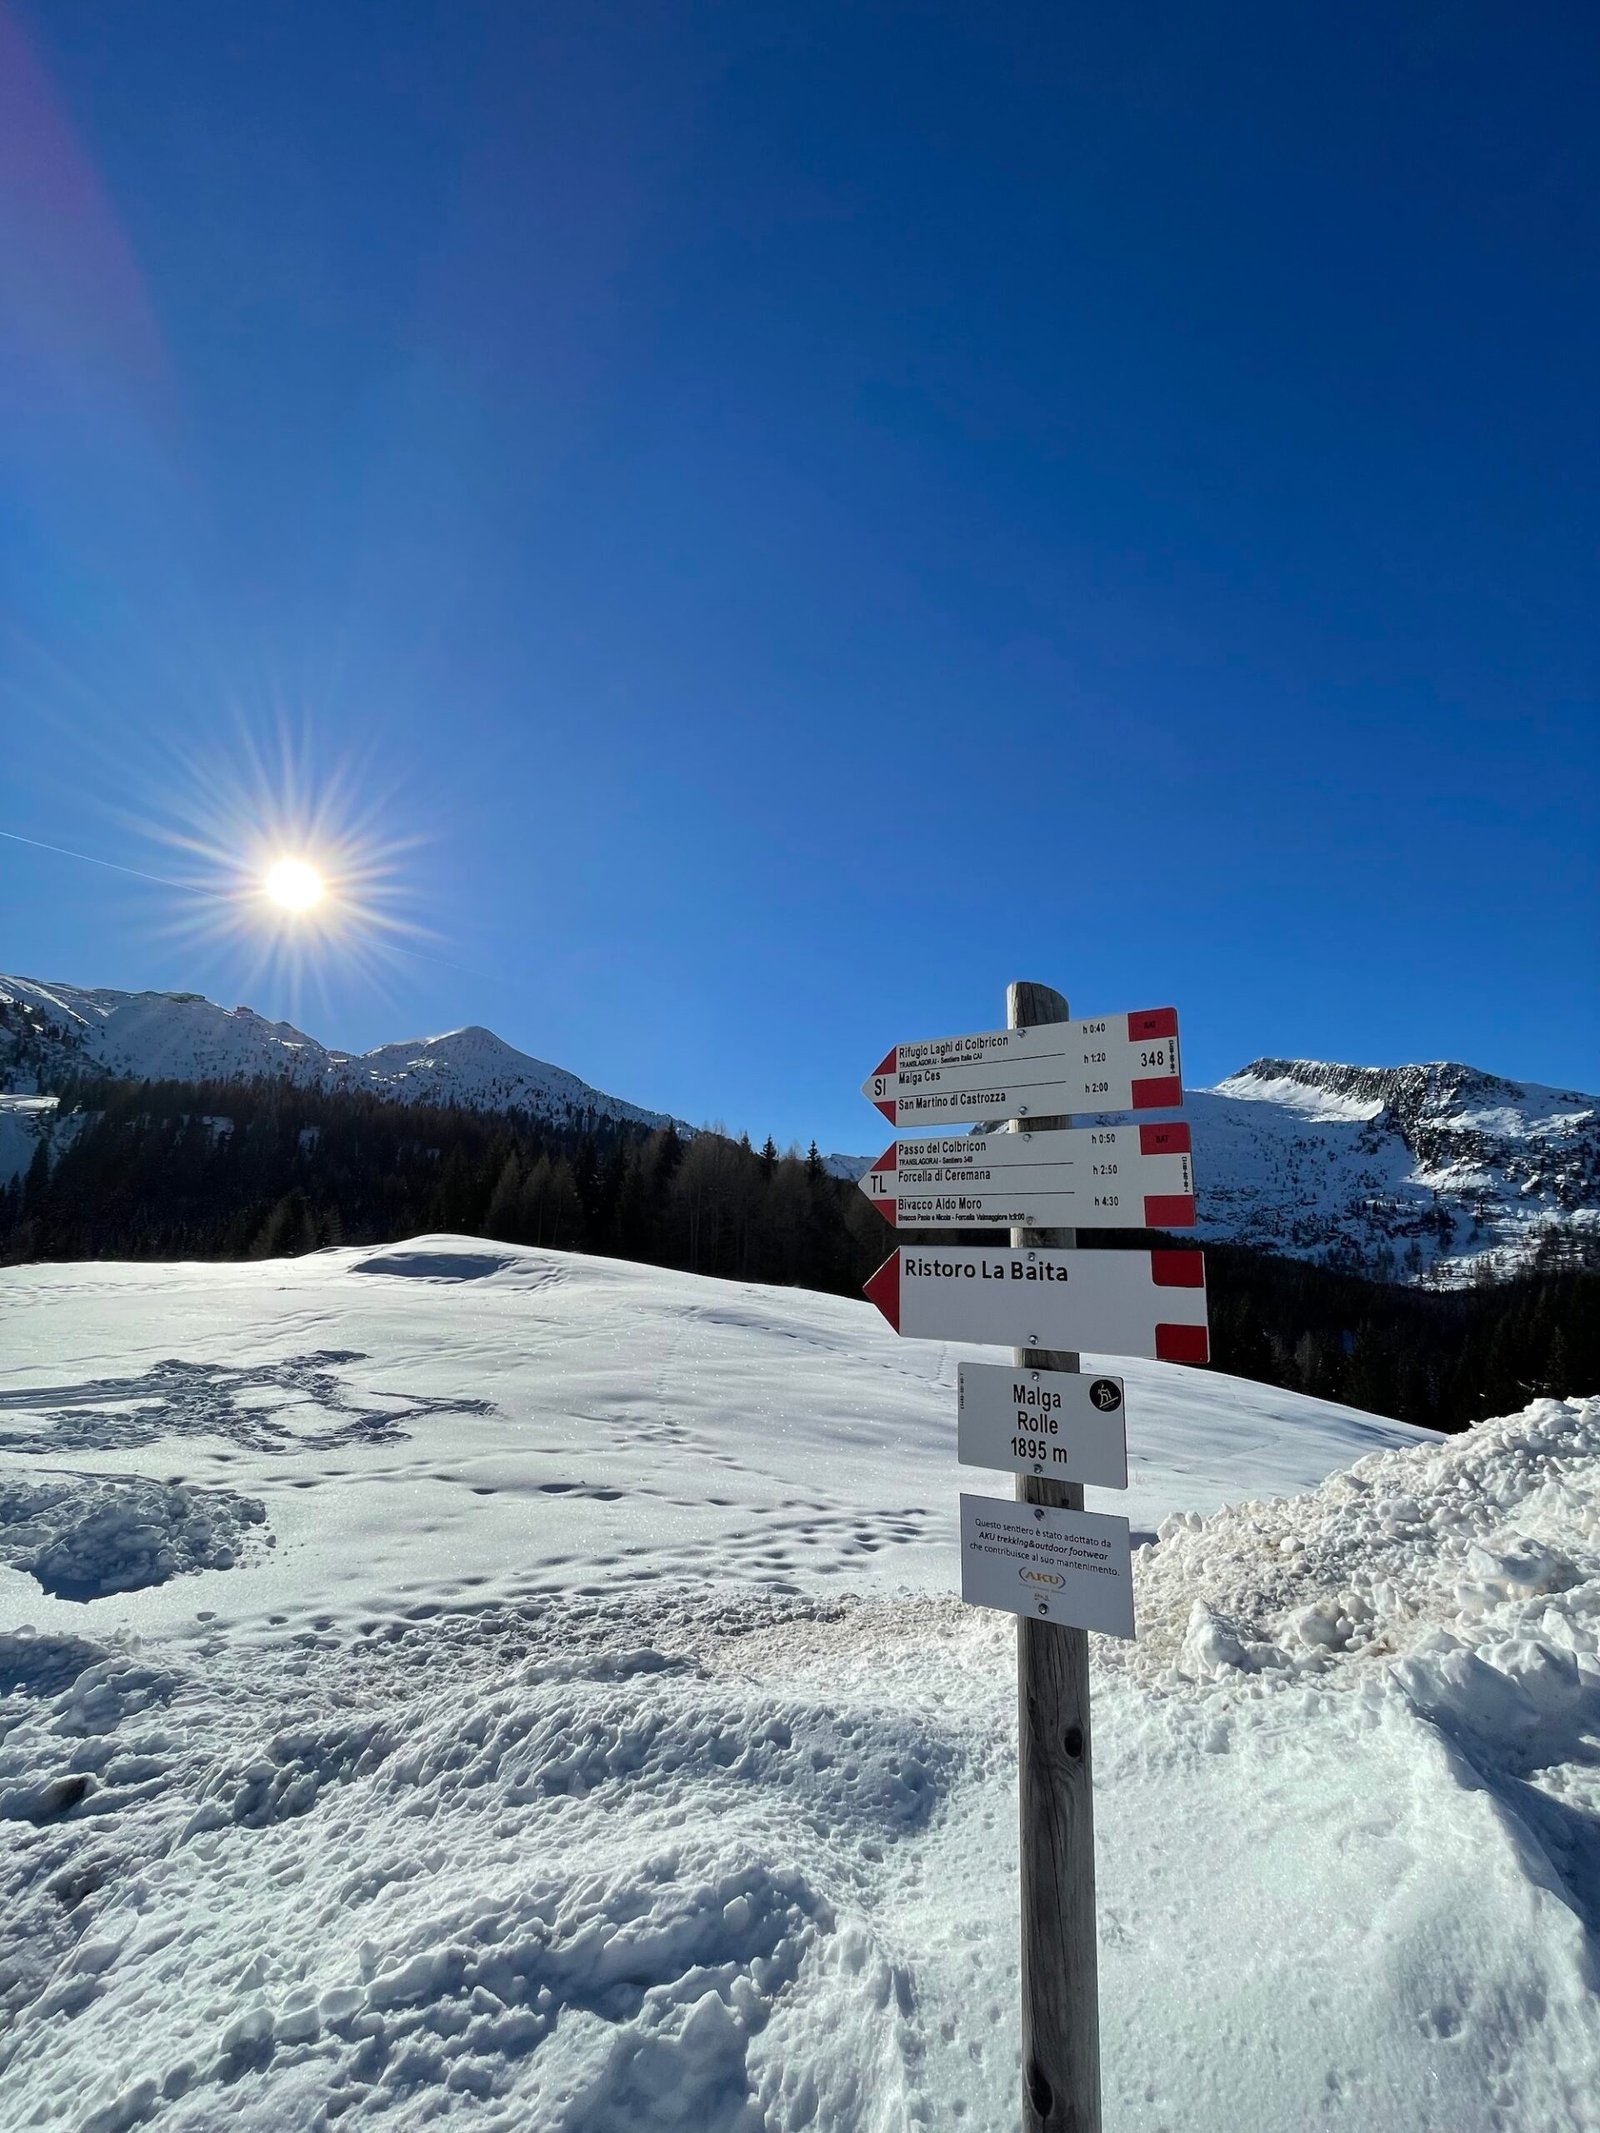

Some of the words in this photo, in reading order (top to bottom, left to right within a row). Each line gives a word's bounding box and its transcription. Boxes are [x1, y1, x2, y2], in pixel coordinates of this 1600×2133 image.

[1083, 1025, 1087, 1033] h
[1090, 1023, 1105, 1033] 0:40
[900, 1045, 928, 1059] Rifugio
[930, 1042, 953, 1056] Laghi
[955, 1041, 963, 1052] di
[965, 1037, 1008, 1049] Colbricon
[1084, 1055, 1088, 1063] h
[1091, 1053, 1106, 1062] 1:20
[1141, 1051, 1164, 1067] 348
[899, 1073, 922, 1085] Malga
[925, 1070, 940, 1081] Ces
[1085, 1084, 1090, 1093] h
[1092, 1082, 1108, 1092] 2:00
[899, 1099, 914, 1110] San
[916, 1096, 947, 1108] Martino
[950, 1095, 958, 1105] di
[961, 1092, 1006, 1105] Castrozza
[1092, 1135, 1096, 1143] h
[1099, 1134, 1116, 1143] 0:50
[899, 1144, 924, 1155] Passo
[927, 1142, 940, 1153] del
[942, 1141, 986, 1153] Colbricon
[899, 1169, 932, 1182] Forcella
[935, 1169, 942, 1180] di
[945, 1170, 990, 1180] Ceremana
[1093, 1165, 1098, 1175] h
[1100, 1165, 1117, 1174] 2:50
[871, 1176, 887, 1193] TL
[899, 1199, 933, 1210] Bivacco
[936, 1198, 956, 1209] Aldo
[959, 1197, 982, 1209] Moro
[1095, 1197, 1099, 1206] h
[1102, 1197, 1119, 1206] 4:30
[905, 1259, 976, 1278] Ristoro
[982, 1261, 1004, 1279] La
[1011, 1261, 1068, 1281] Baita
[1013, 1384, 1061, 1411] Malga
[1018, 1411, 1058, 1434] Rolle
[1011, 1437, 1046, 1460] 1895
[1053, 1448, 1067, 1463] m
[975, 1518, 1001, 1529] Questo
[1003, 1523, 1033, 1535] sentiero
[1036, 1527, 1040, 1536] è
[1042, 1531, 1062, 1540] stato
[1064, 1534, 1099, 1546] adottato
[1101, 1539, 1111, 1548] da
[979, 1531, 995, 1540] AKU
[997, 1535, 1068, 1554] trekking&outdoor
[1068, 1547, 1108, 1560] footwear
[970, 1542, 982, 1551] che
[984, 1545, 1030, 1560] contribuisce
[1032, 1553, 1038, 1561] al
[1041, 1556, 1054, 1565] suo
[1057, 1559, 1120, 1576] mantenimento.
[1025, 1571, 1059, 1585] AKU
